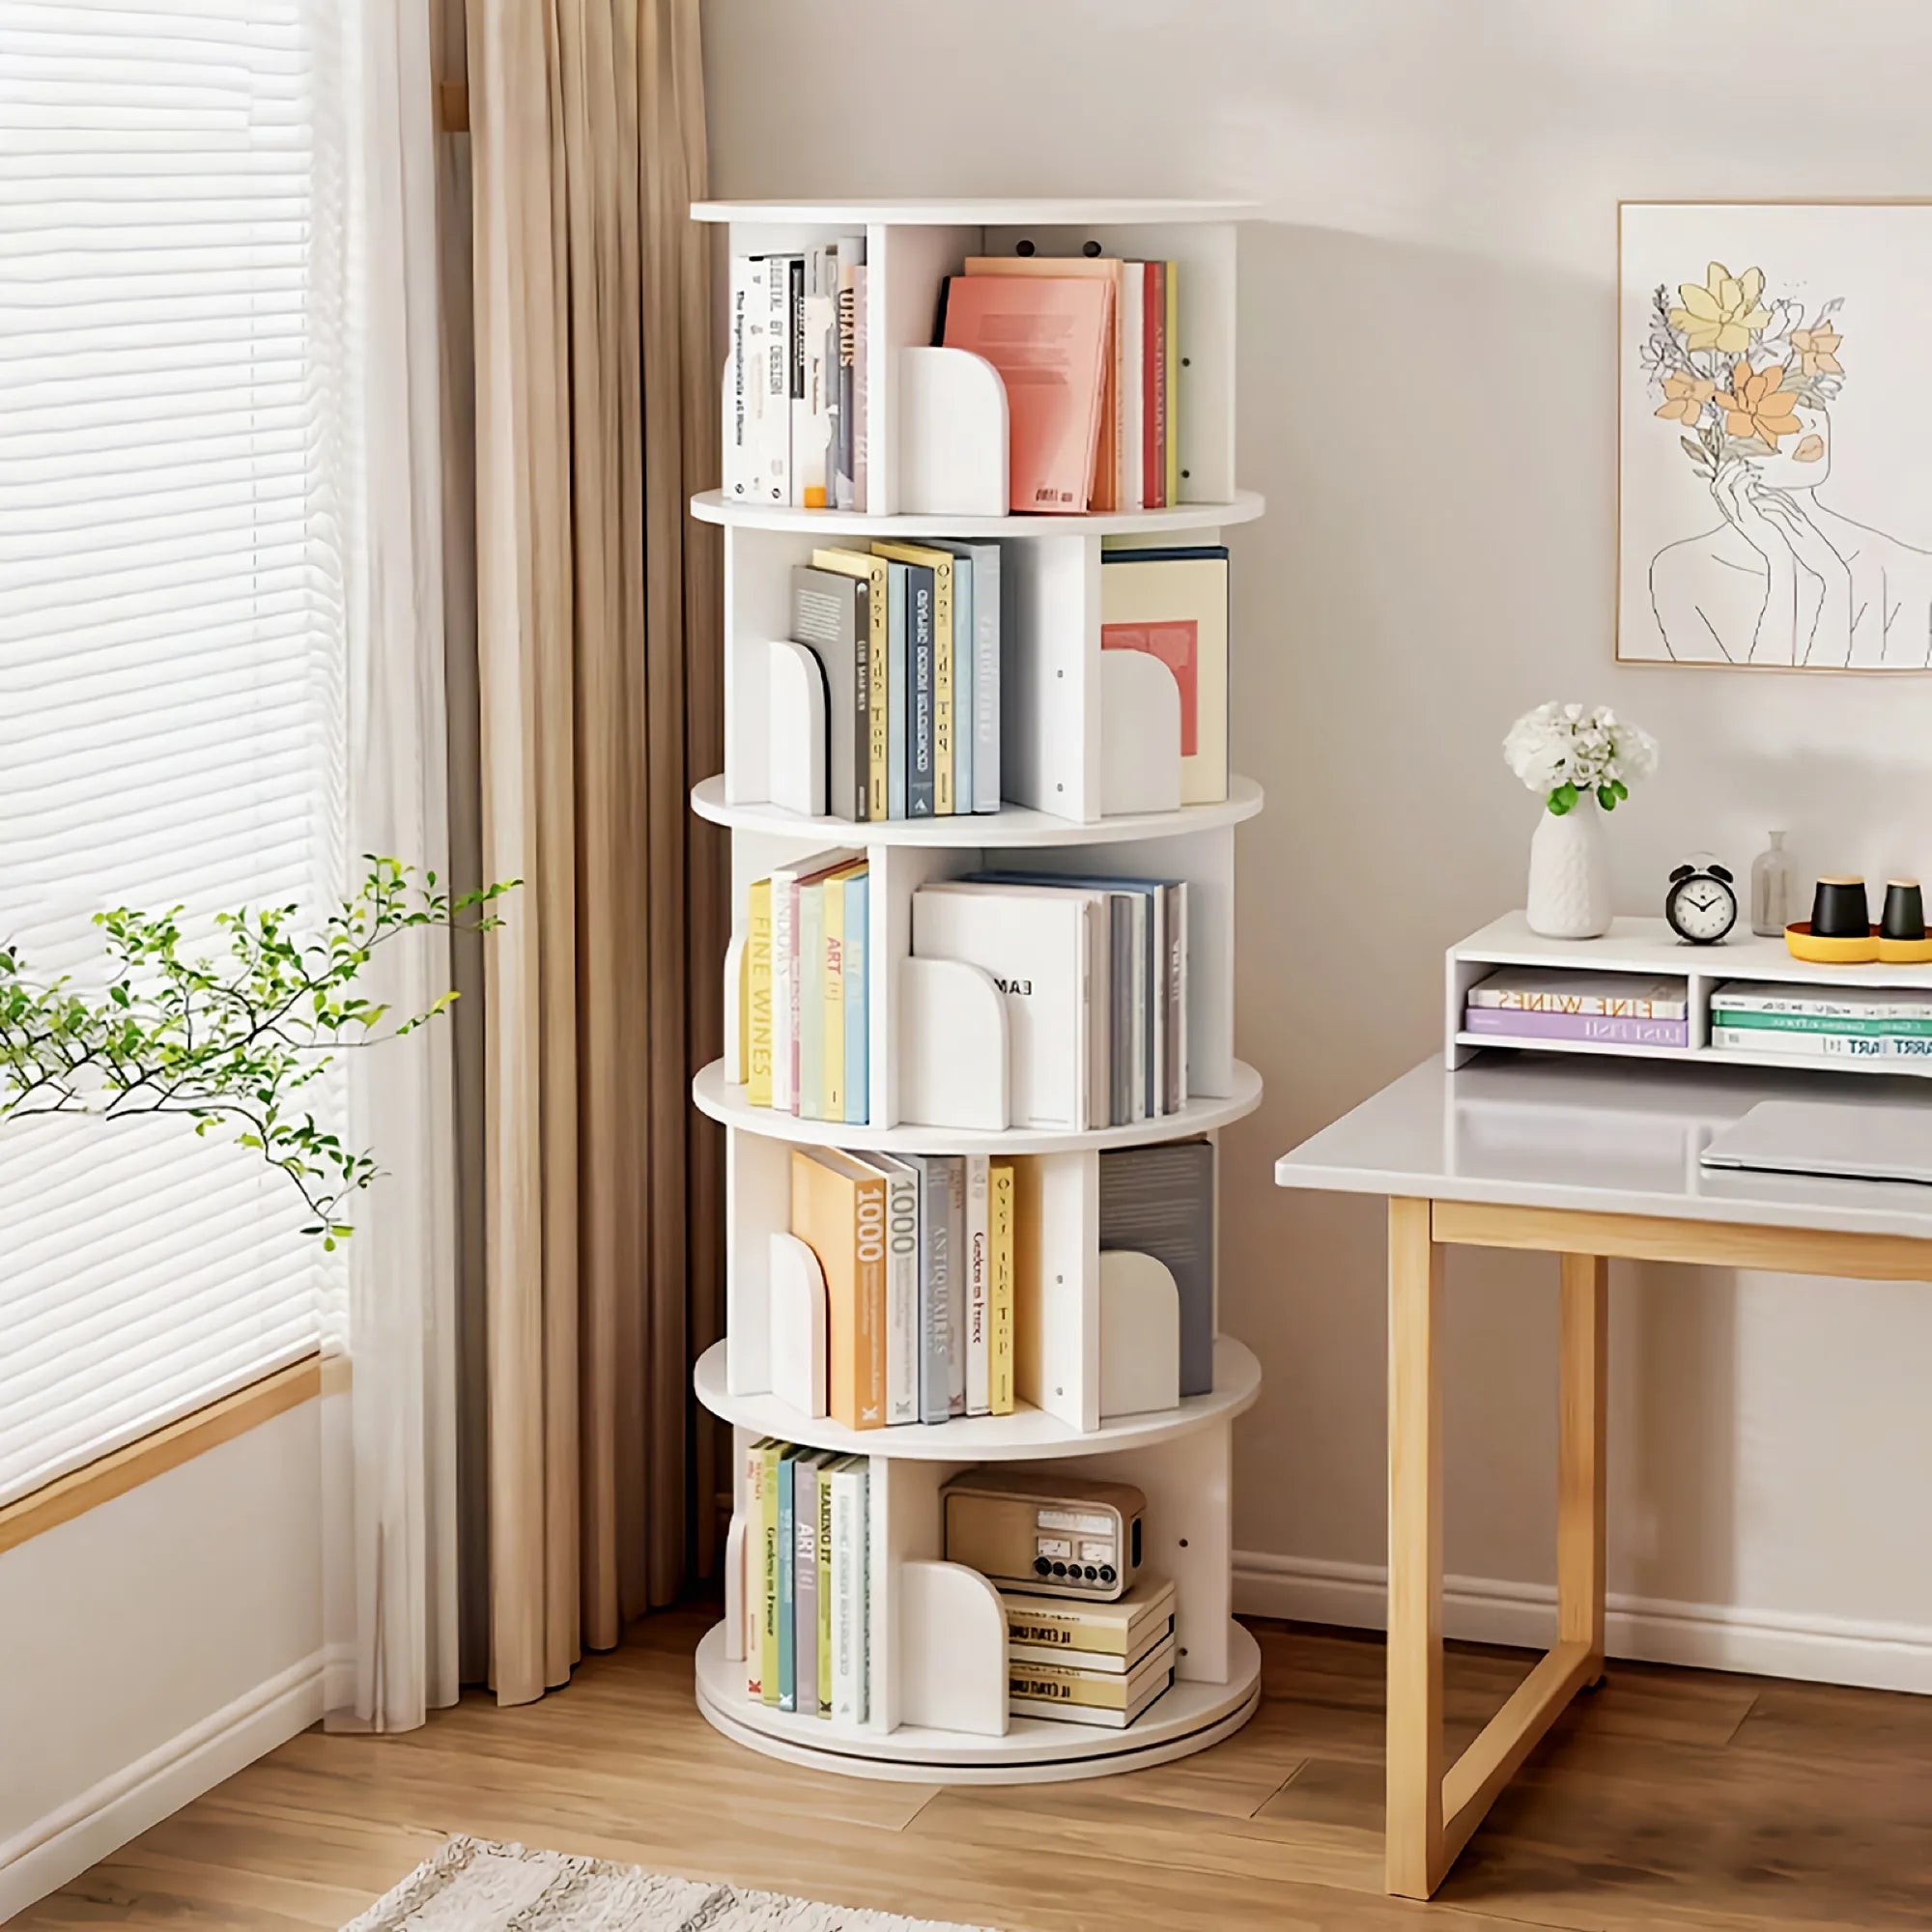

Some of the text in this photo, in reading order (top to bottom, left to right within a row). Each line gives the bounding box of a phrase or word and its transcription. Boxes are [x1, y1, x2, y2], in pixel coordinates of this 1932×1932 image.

[770, 320, 783, 336] BY
[770, 346, 783, 395] DESIGN
[827, 937, 841, 975] ART
[753, 917, 772, 1076] FINE WINES
[857, 1189, 884, 1262] 1000
[891, 1180, 916, 1254] 1000
[973, 1232, 984, 1283] Gardens
[930, 1225, 949, 1354] ANTIQUAIRES
[820, 1483, 831, 1544] MAKING
[797, 1522, 814, 1564] ART
[821, 1548, 831, 1564] IT
